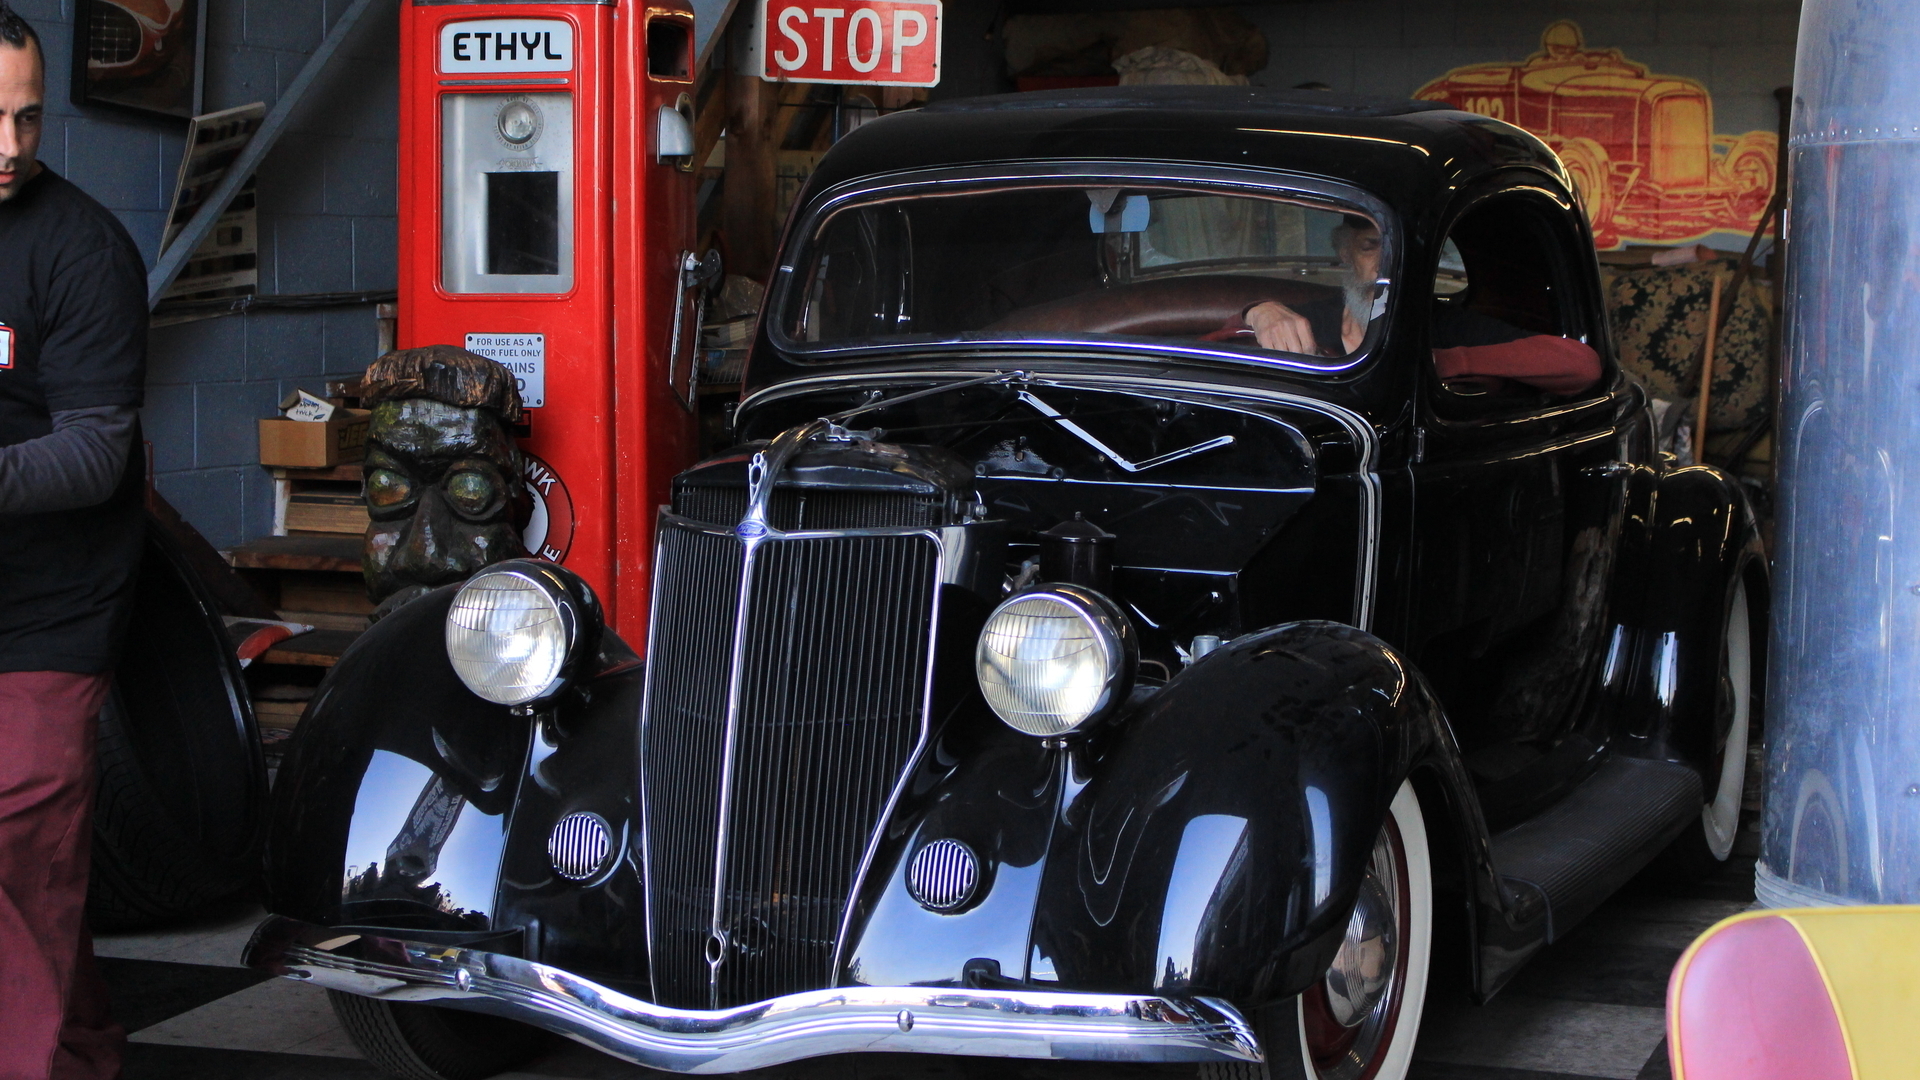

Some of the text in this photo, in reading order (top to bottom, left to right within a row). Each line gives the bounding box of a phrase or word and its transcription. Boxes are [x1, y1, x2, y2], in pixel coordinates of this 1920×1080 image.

[453, 32, 562, 61] ETHYL
[774, 6, 928, 73] STOP
[476, 338, 533, 346] FOR USE AS A
[498, 349, 519, 357] FUEL
[521, 349, 541, 357] ONLY
